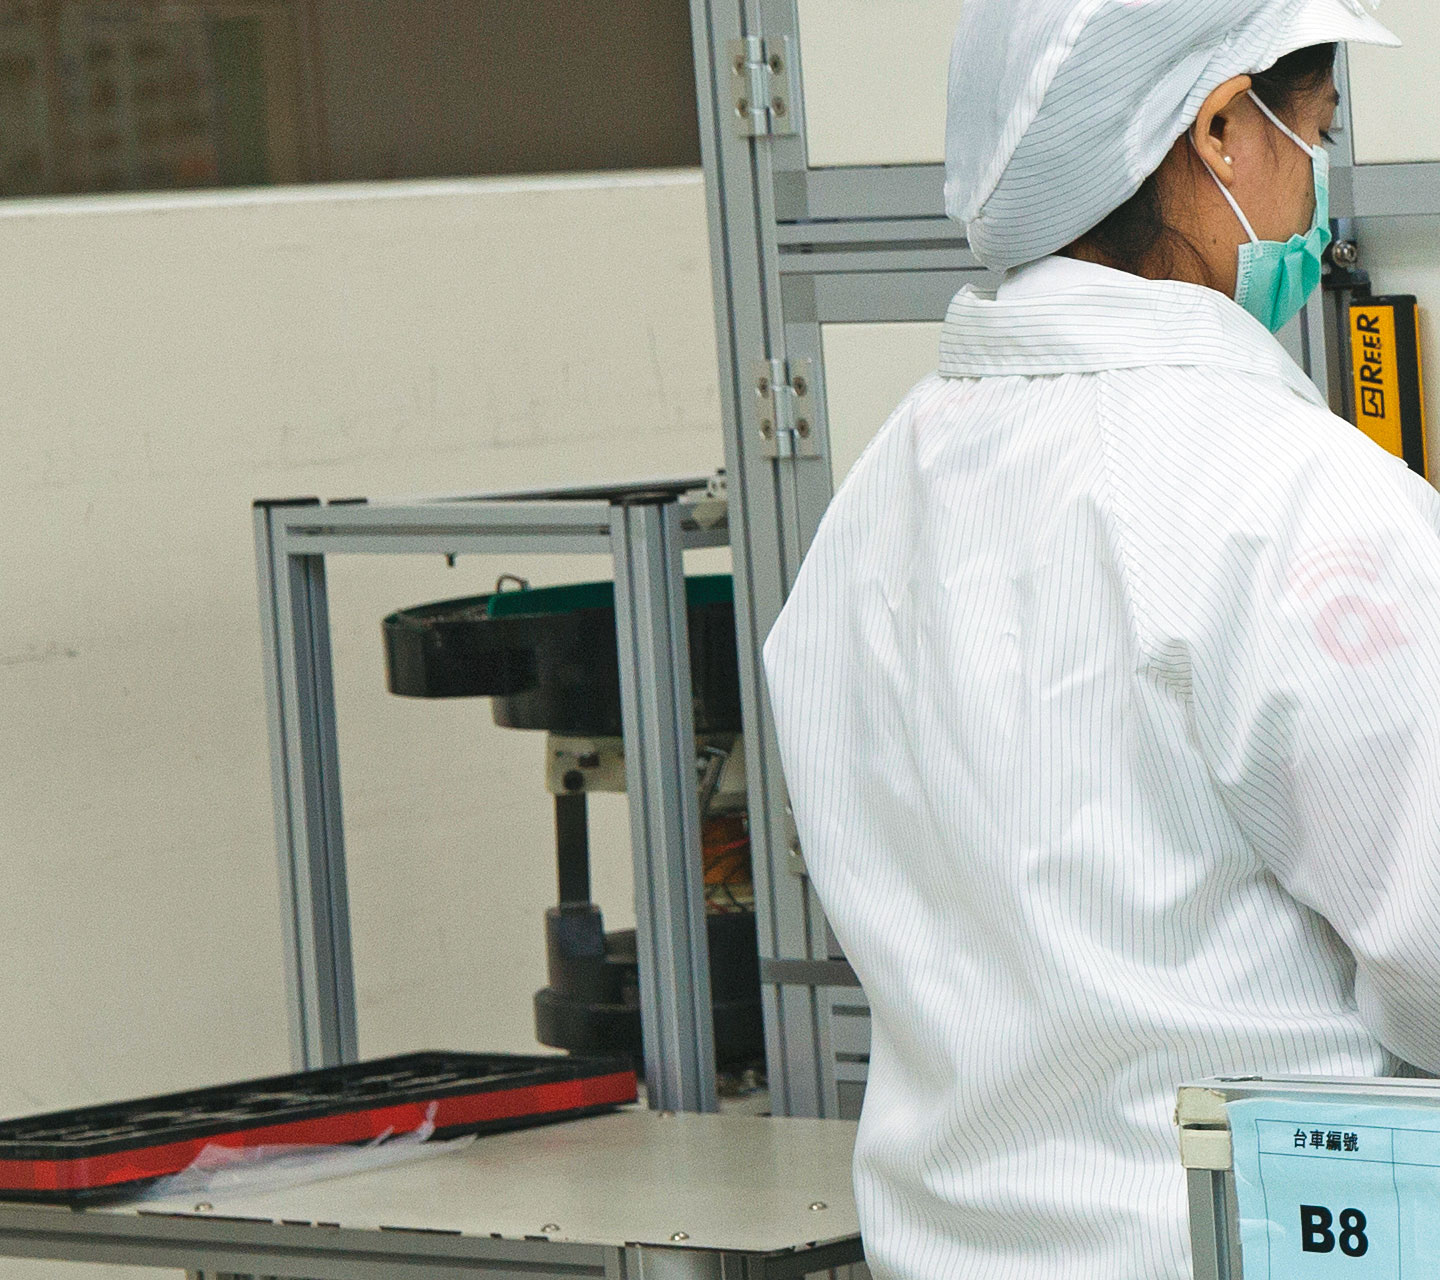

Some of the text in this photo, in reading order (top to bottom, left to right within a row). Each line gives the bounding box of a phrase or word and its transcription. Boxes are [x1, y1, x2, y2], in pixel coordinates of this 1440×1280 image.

[1357, 313, 1384, 385] REER
[1292, 1128, 1360, 1153] 台車編號
[1299, 1203, 1370, 1258] B8
